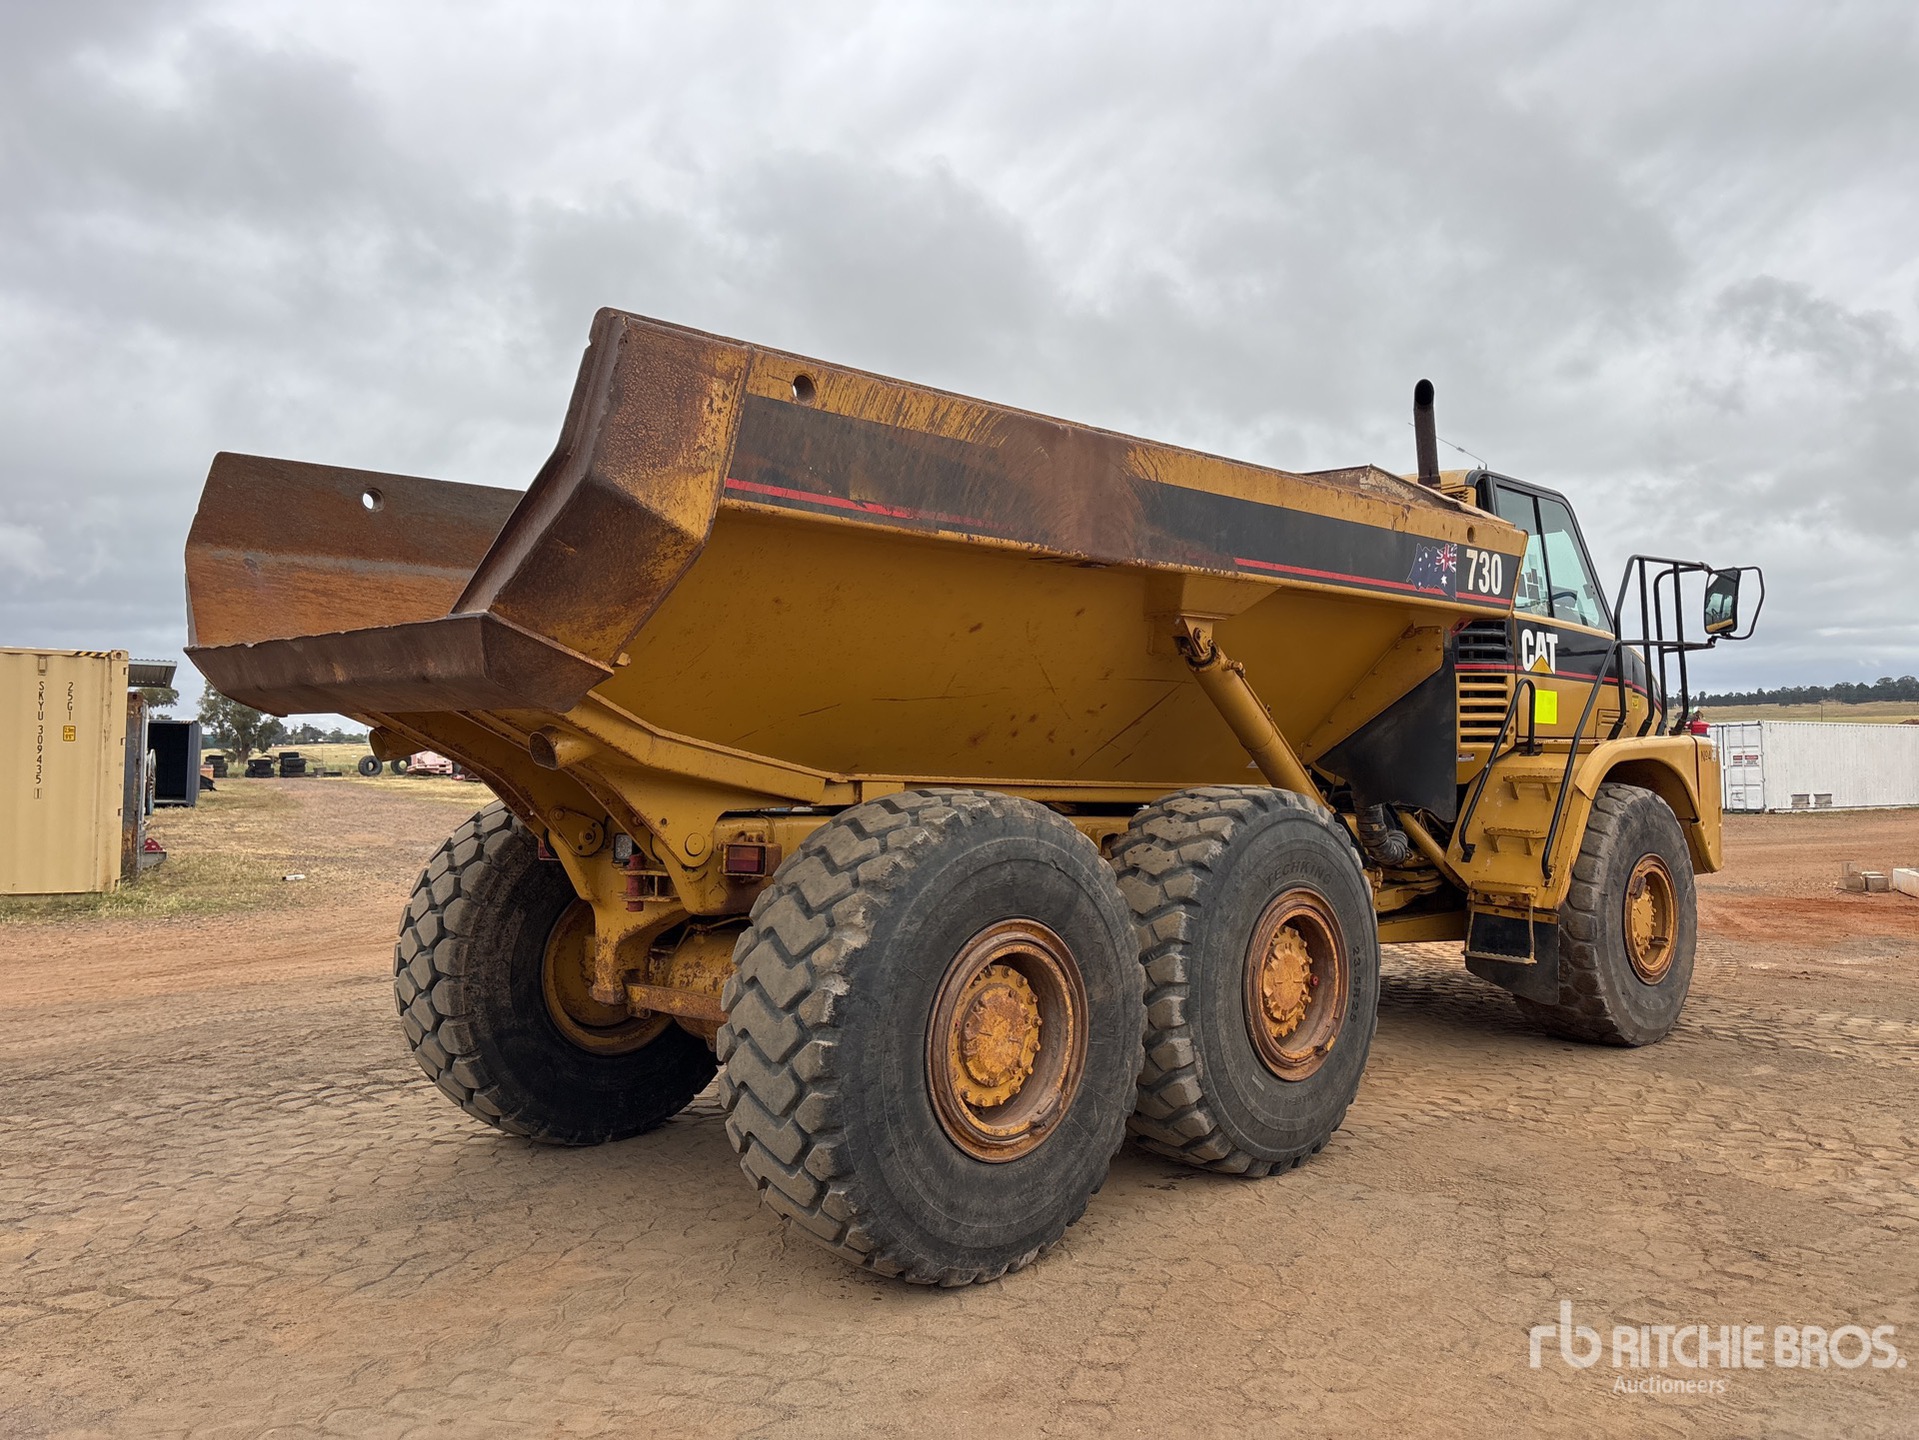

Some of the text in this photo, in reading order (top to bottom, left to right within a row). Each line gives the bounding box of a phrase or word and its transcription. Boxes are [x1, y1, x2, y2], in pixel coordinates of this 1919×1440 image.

[1466, 549, 1503, 595] 730
[1521, 629, 1559, 675] CAT
[37, 681, 45, 721] SKYU
[36, 724, 44, 785] 309435
[1265, 861, 1332, 887] TECHKING
[1350, 945, 1361, 1023] 23.5R25
